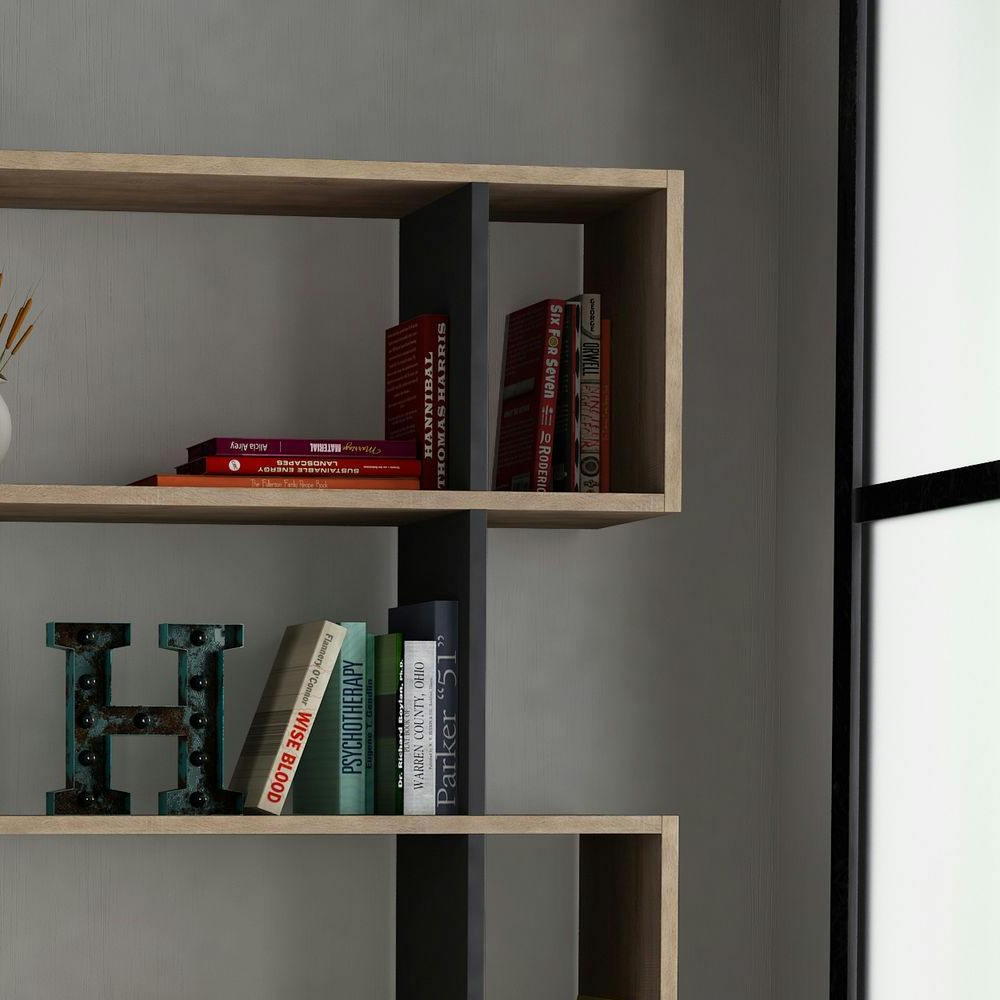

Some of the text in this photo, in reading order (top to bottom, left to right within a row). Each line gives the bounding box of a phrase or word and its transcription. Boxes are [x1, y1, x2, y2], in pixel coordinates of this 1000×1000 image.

[424, 352, 433, 459] HANNIBAL
[438, 323, 446, 489] THOMAS HARRIS
[583, 342, 600, 376] ORWELL
[249, 443, 267, 451] Alicia
[310, 443, 341, 452] MATERIAL
[301, 632, 334, 707] Flannery O'Connor
[342, 660, 363, 774] PSYCHOTHERAPY
[266, 711, 313, 804] WISE BLOOD
[413, 662, 425, 790] WARREN COUNTY, OHIO
[437, 709, 457, 807] Parker
